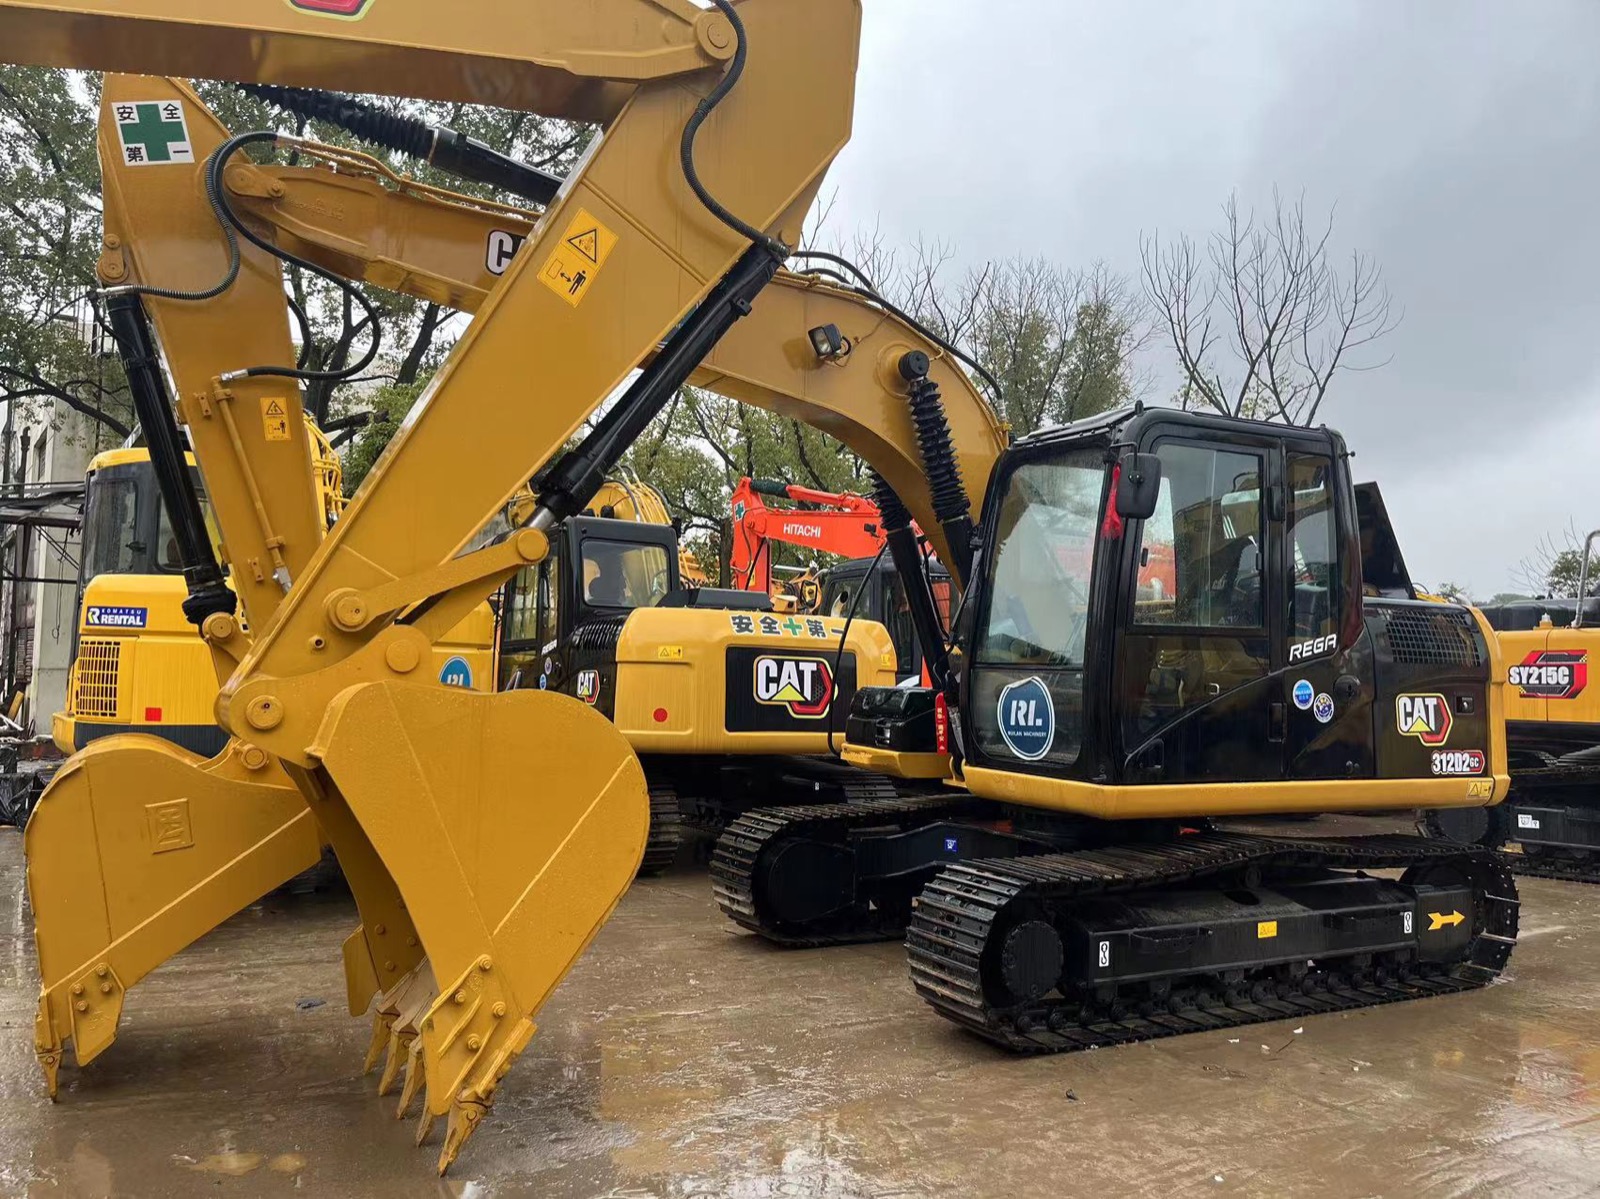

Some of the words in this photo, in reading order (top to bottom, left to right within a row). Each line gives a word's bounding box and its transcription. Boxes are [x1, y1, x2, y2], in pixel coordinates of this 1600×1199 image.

[783, 523, 821, 538] HITACHI
[101, 614, 143, 625] RENTAL
[1289, 634, 1337, 661] REGA
[578, 671, 595, 696] CAT
[757, 658, 818, 701] CAT
[1509, 666, 1570, 685] SY215C
[1398, 696, 1438, 732] CAT
